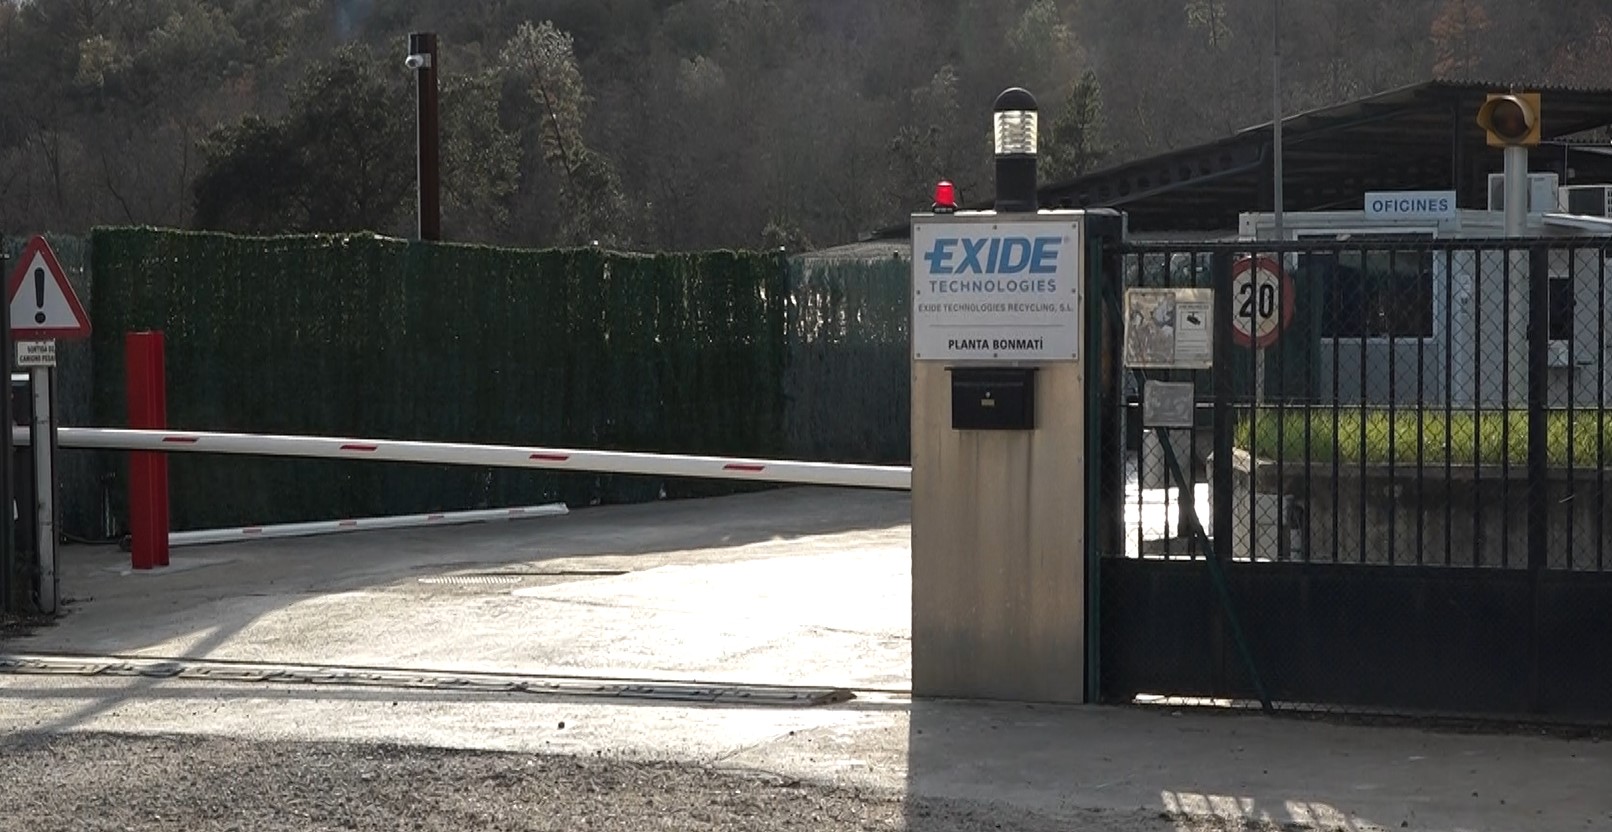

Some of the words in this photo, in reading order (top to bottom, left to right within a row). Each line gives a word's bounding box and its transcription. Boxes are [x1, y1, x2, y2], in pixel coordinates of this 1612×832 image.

[1372, 199, 1448, 213] OFICINES
[924, 236, 1062, 275] EXIDE
[929, 280, 1057, 293] TECHNOLOGIES
[1239, 283, 1274, 318] 20
[918, 303, 942, 312] EXIDE
[944, 303, 1006, 312] TECHNOLOGIES
[1008, 303, 1057, 314] RECYCLING,
[1059, 303, 1074, 312] S.L.
[948, 339, 989, 350] PLANTA
[992, 336, 1044, 350] BONMATÍ
